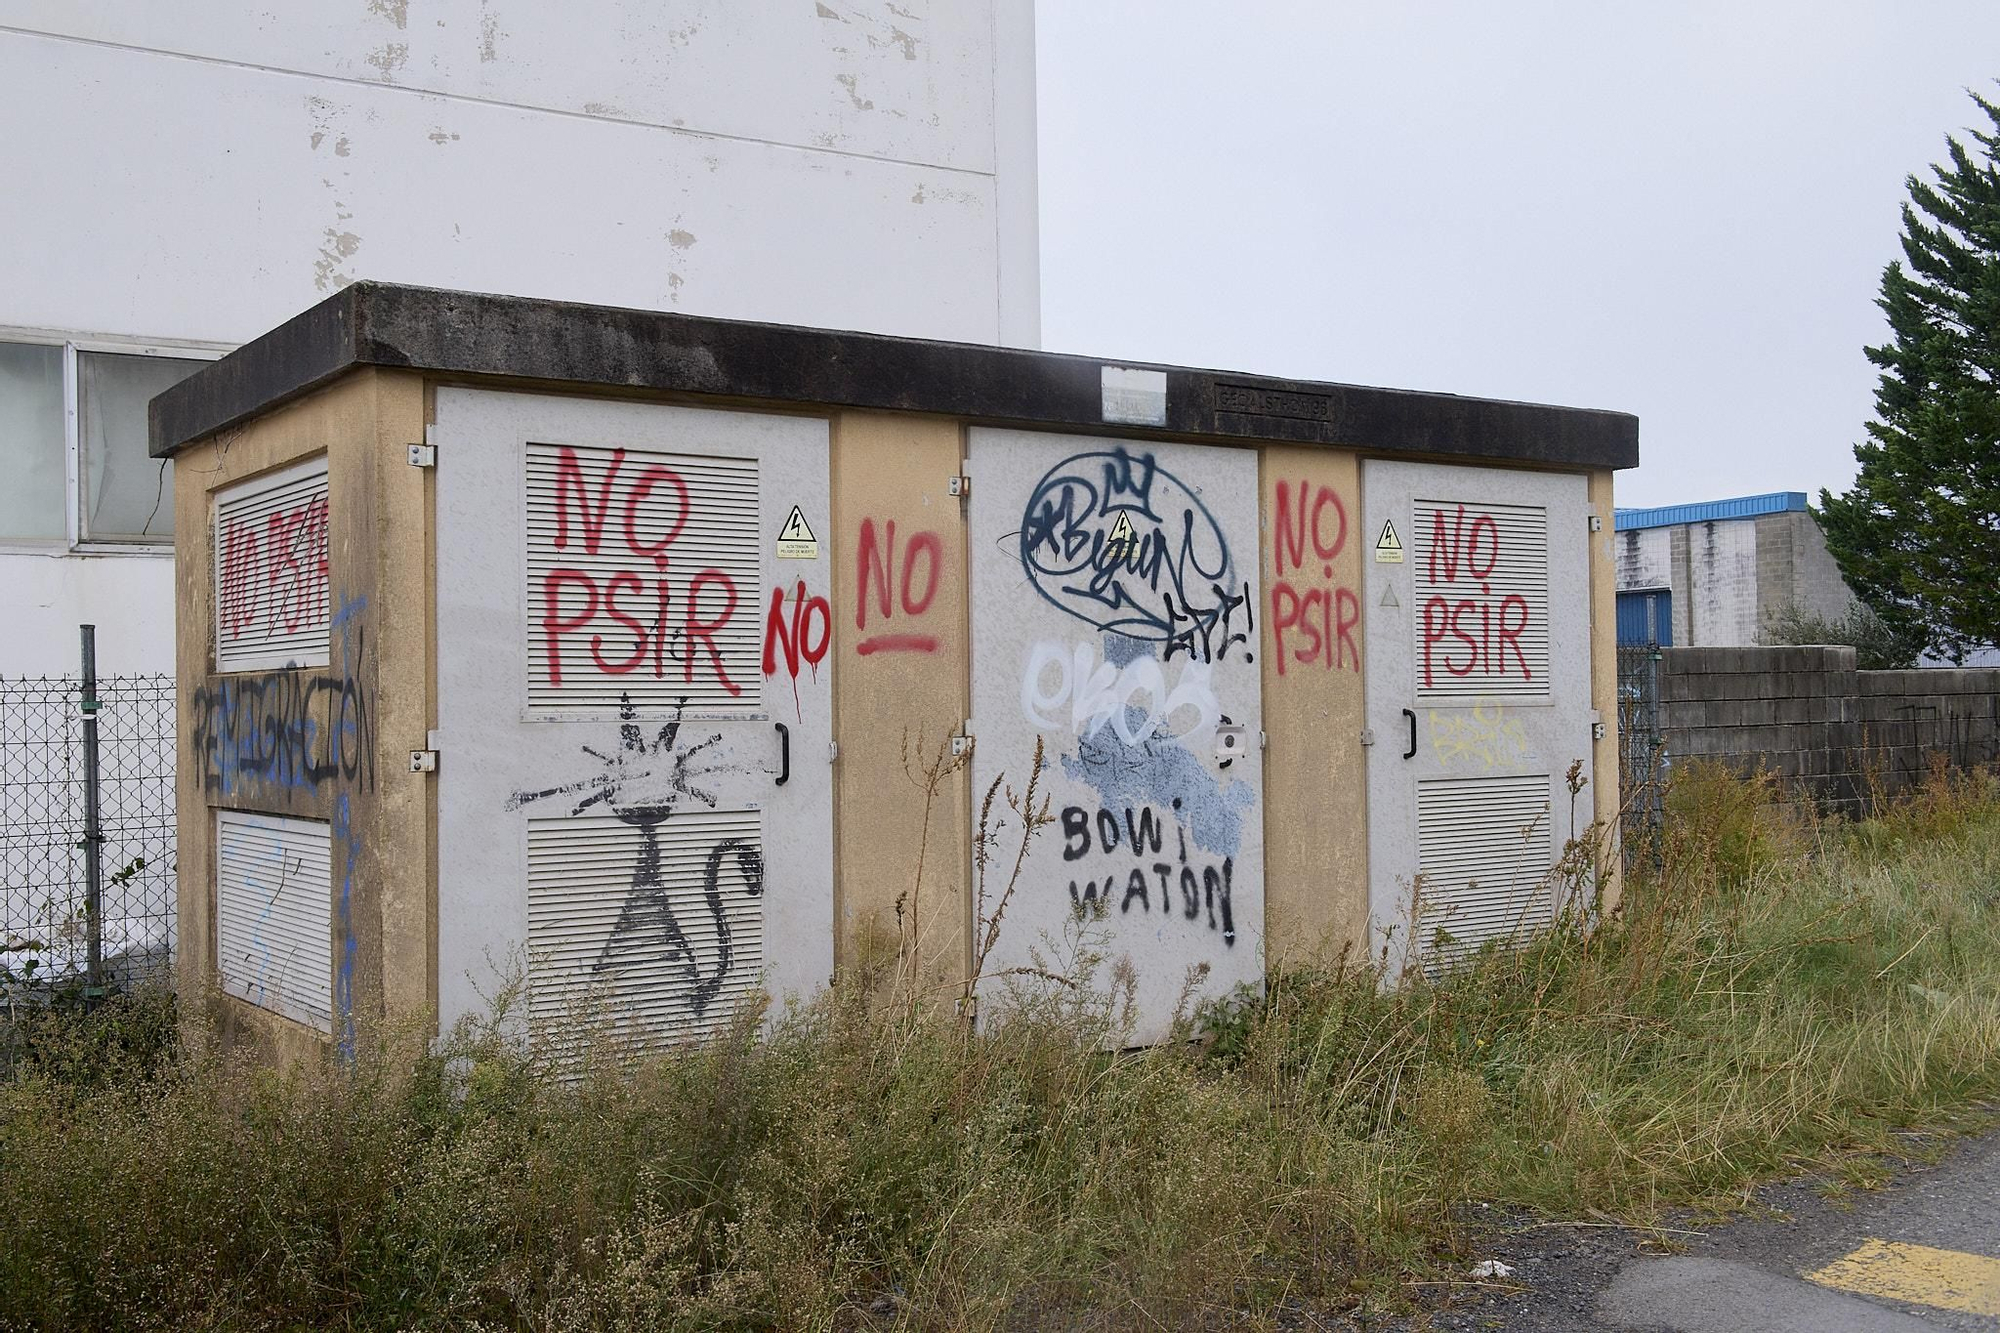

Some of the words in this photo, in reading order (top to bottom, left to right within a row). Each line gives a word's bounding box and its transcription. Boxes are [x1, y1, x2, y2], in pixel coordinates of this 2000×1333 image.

[553, 446, 691, 556] NO
[1273, 478, 1348, 579] NO
[1428, 504, 1499, 586] NO
[855, 515, 944, 631] NO
[762, 580, 831, 684] NO
